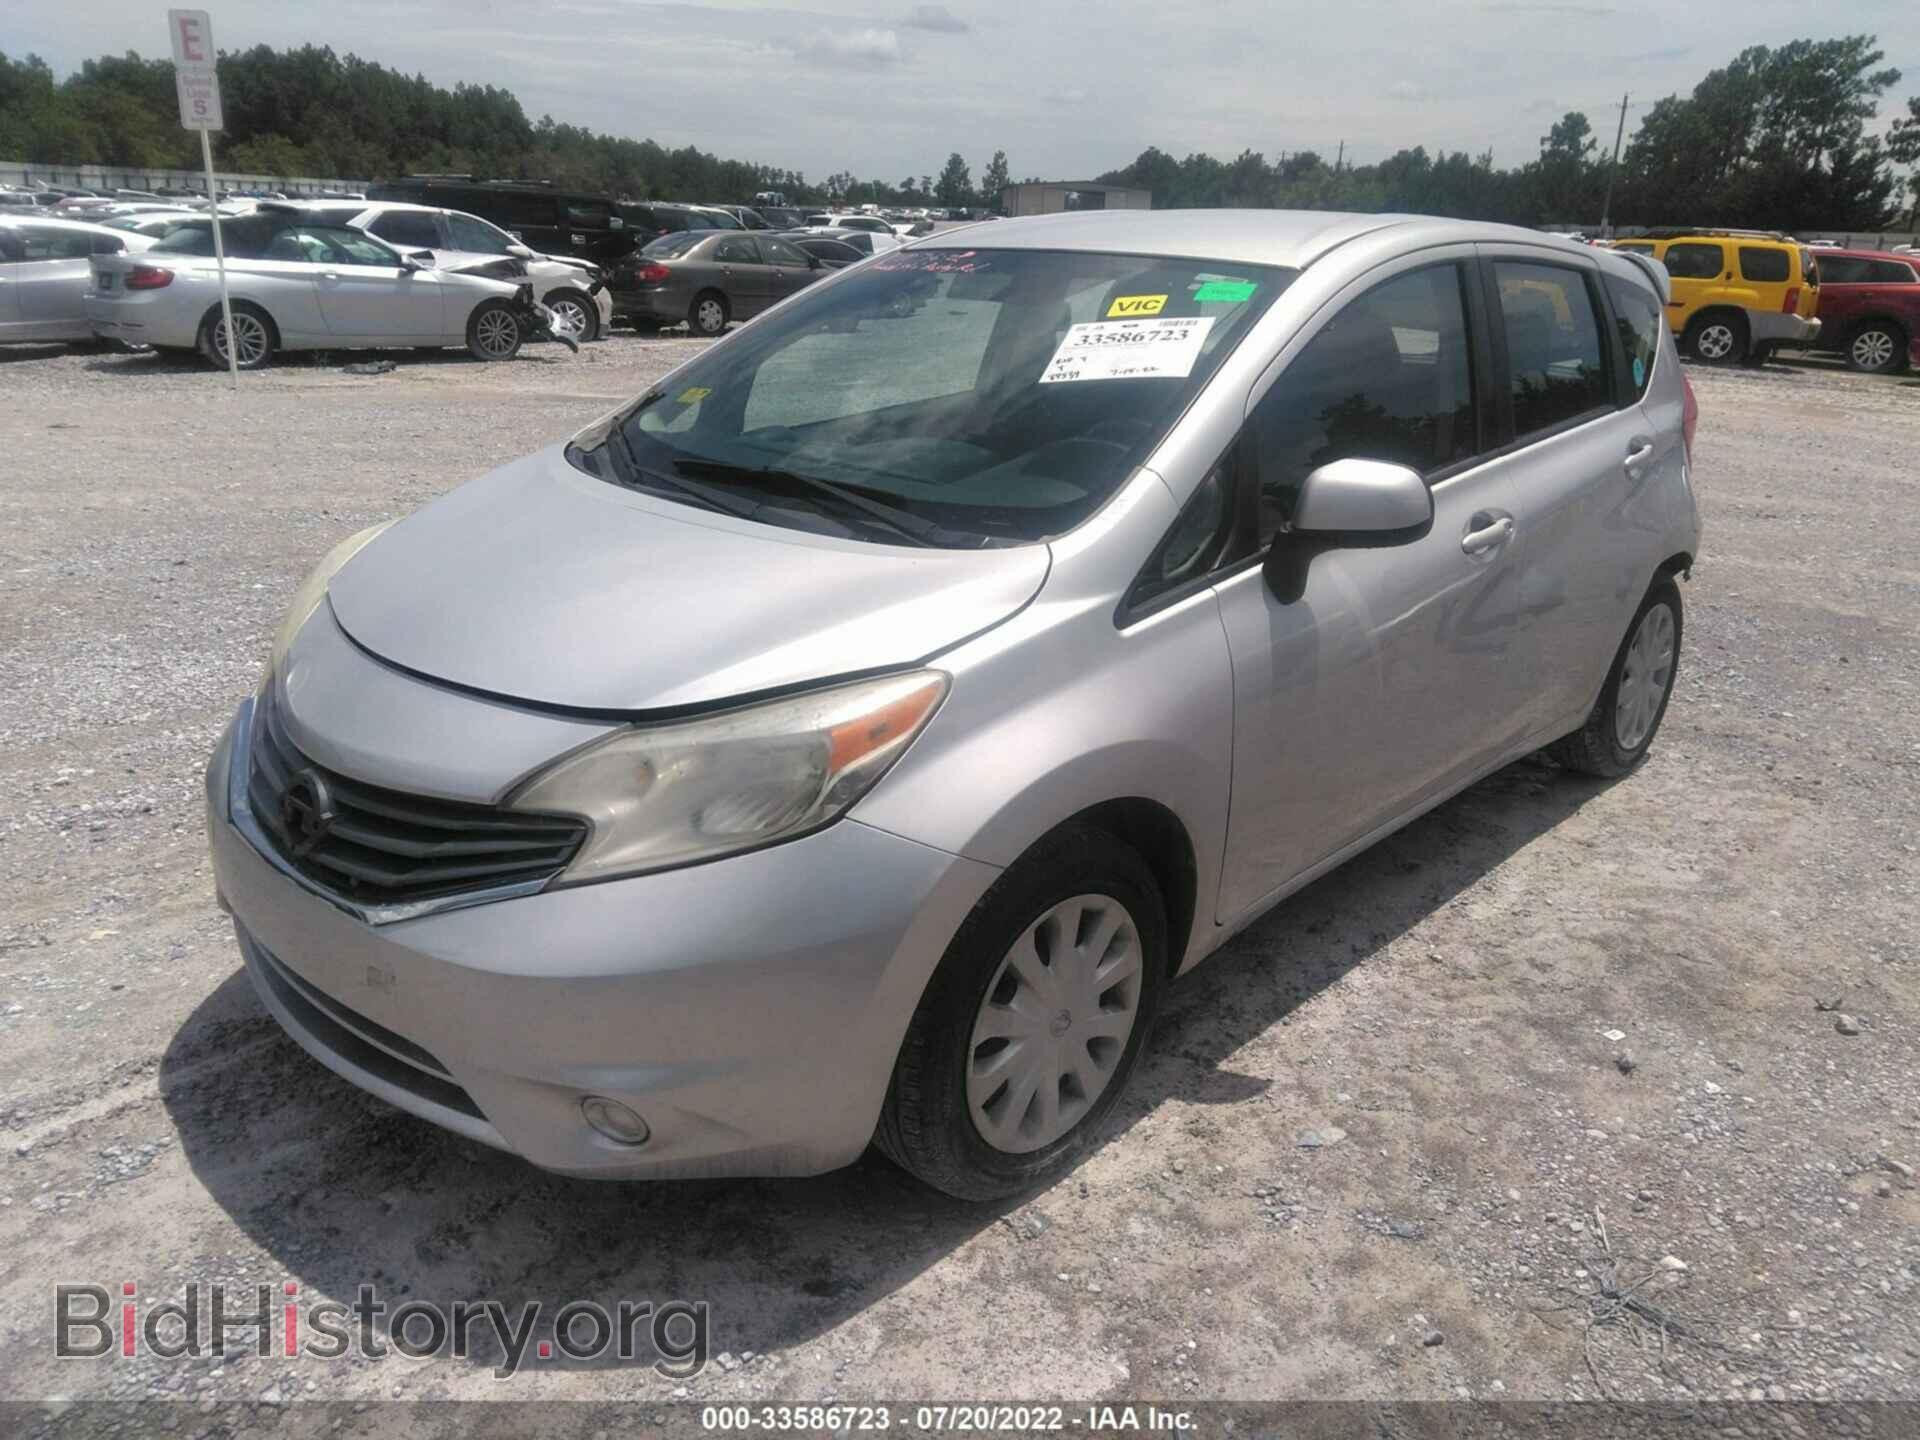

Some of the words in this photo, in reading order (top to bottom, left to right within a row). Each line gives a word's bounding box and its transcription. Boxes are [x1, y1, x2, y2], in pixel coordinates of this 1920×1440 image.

[177, 16, 207, 61] E
[1117, 299, 1161, 312] VIC
[1073, 329, 1190, 347] 33586723
